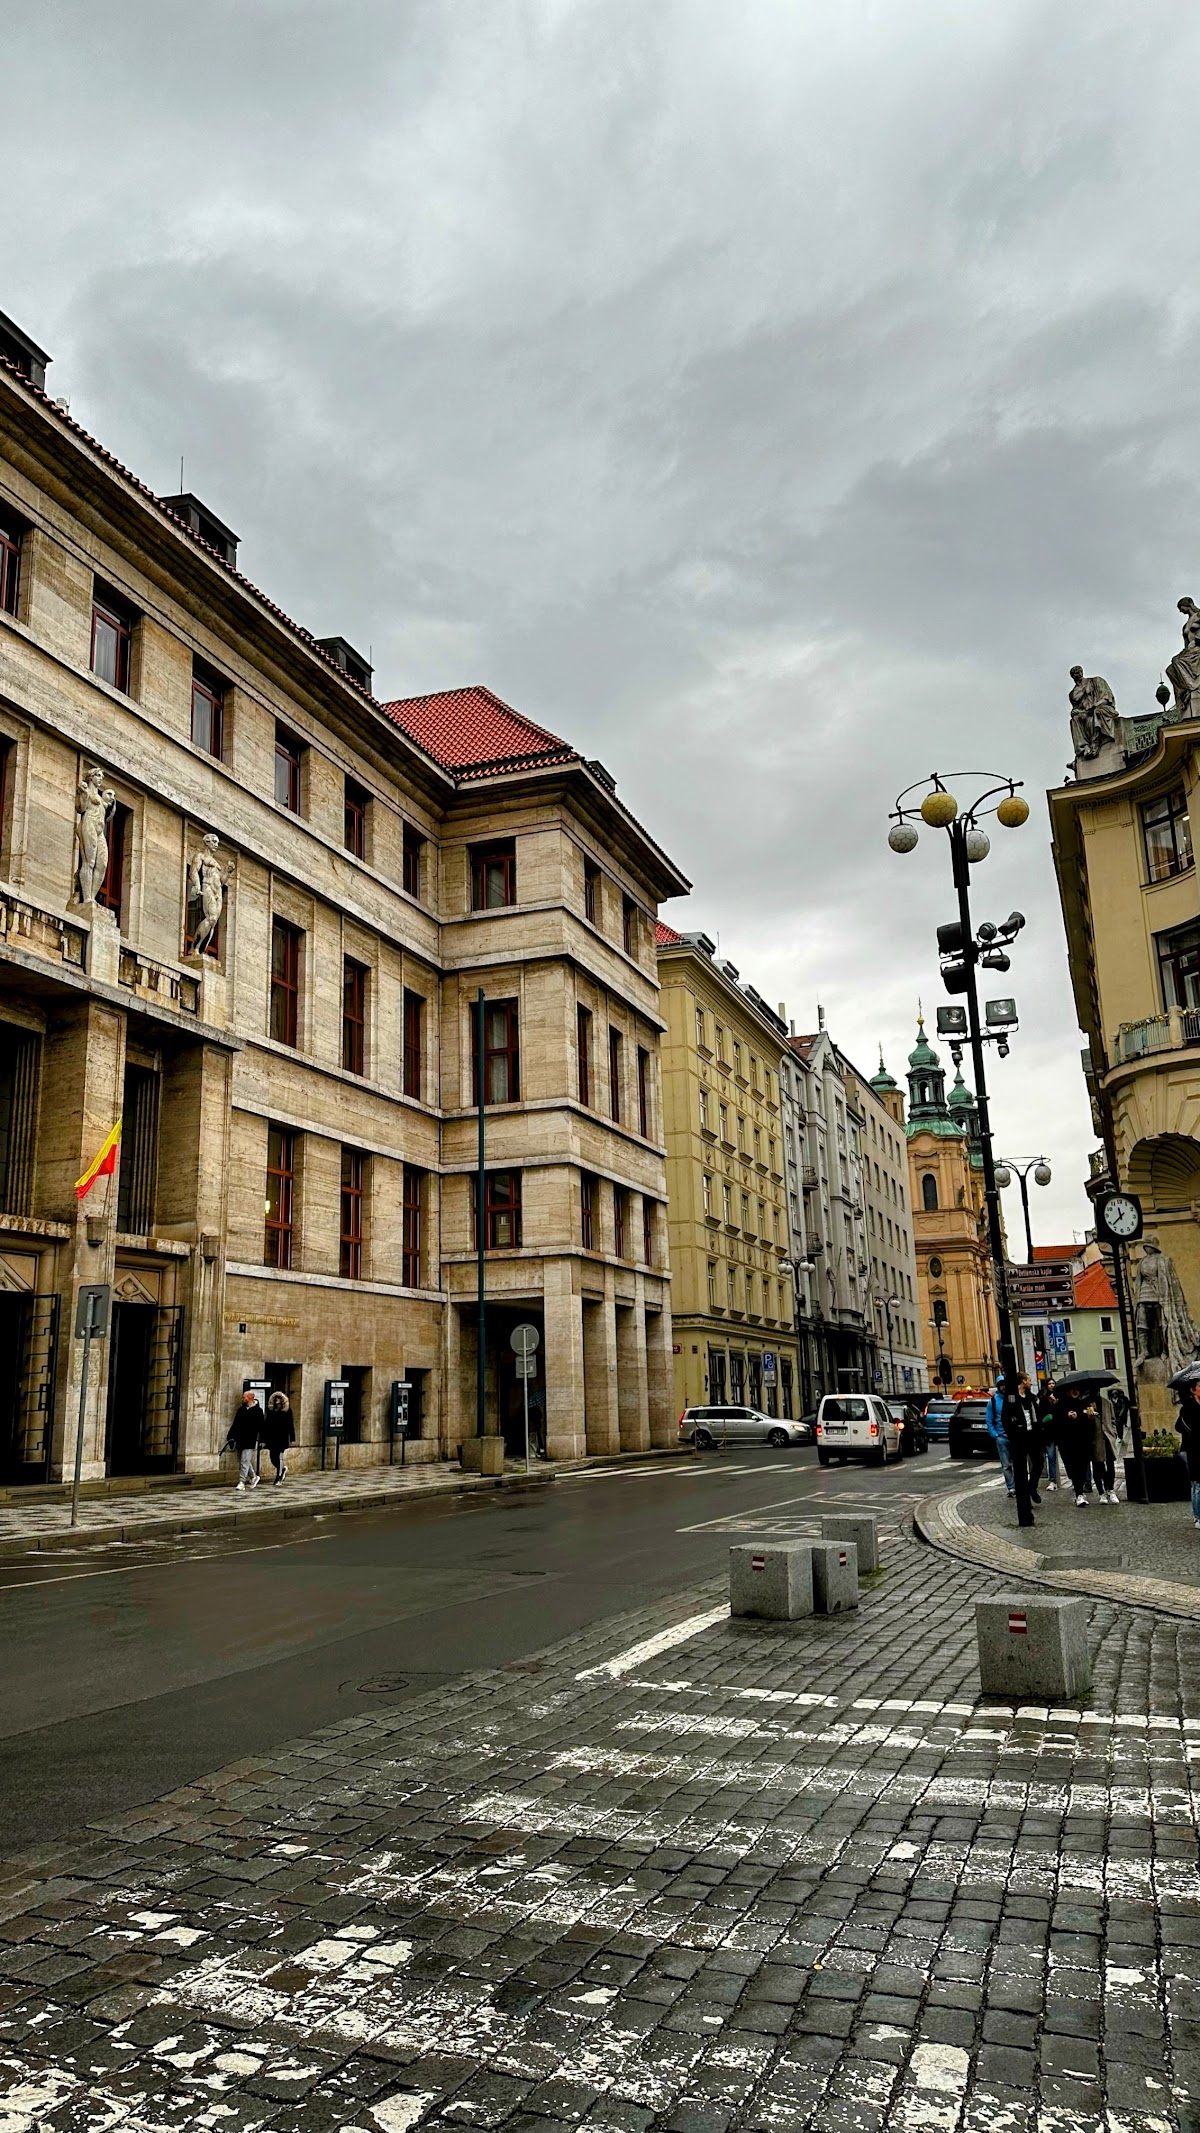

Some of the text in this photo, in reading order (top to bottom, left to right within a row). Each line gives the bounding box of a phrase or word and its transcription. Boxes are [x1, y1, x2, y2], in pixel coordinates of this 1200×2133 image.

[1040, 1267, 1053, 1277] kaple
[1034, 1284, 1046, 1292] most
[1055, 1336, 1064, 1348] P
[764, 1354, 772, 1364] P
[905, 1371, 910, 1379] P
